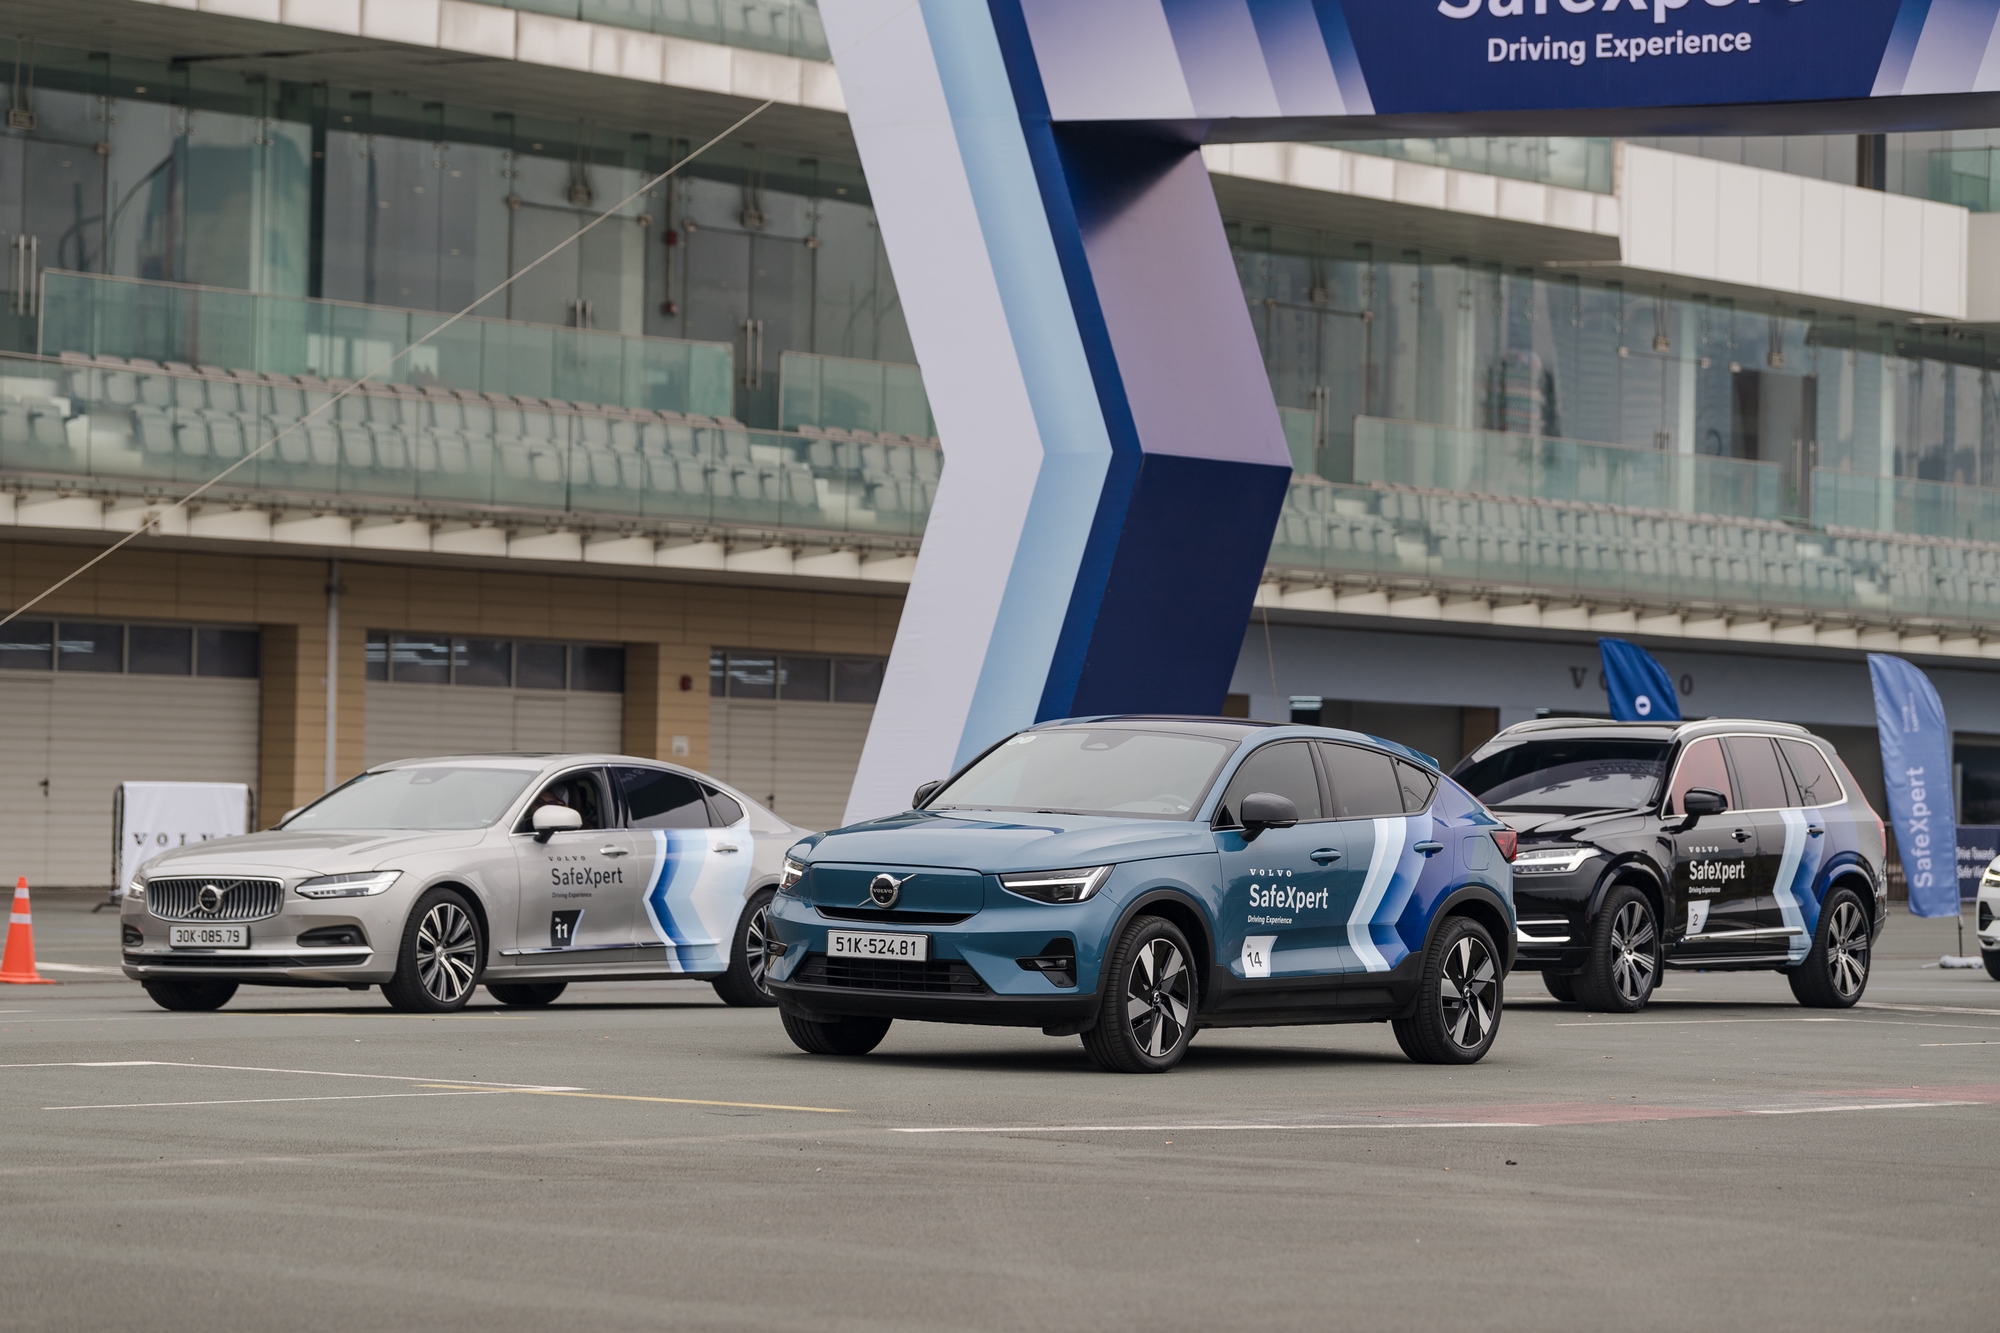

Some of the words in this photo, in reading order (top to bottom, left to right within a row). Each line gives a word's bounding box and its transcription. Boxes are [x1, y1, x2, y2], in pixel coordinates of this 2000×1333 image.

[1487, 35, 1586, 66] Driving
[1595, 30, 1752, 62] Experience
[1906, 765, 1933, 889] SafeXpert
[551, 867, 623, 888] SafeXpert
[1249, 868, 1292, 877] VOLVO
[1689, 859, 1745, 884] SafeXpert
[1249, 884, 1329, 913] SafeXpert
[1247, 914, 1265, 925] Driving
[1265, 915, 1292, 925] Experience
[1692, 913, 1699, 926] 2
[176, 929, 240, 943] 30K-085.79
[555, 923, 568, 938] 11
[835, 937, 916, 956] 51K-524.81
[1247, 951, 1262, 968] 14
